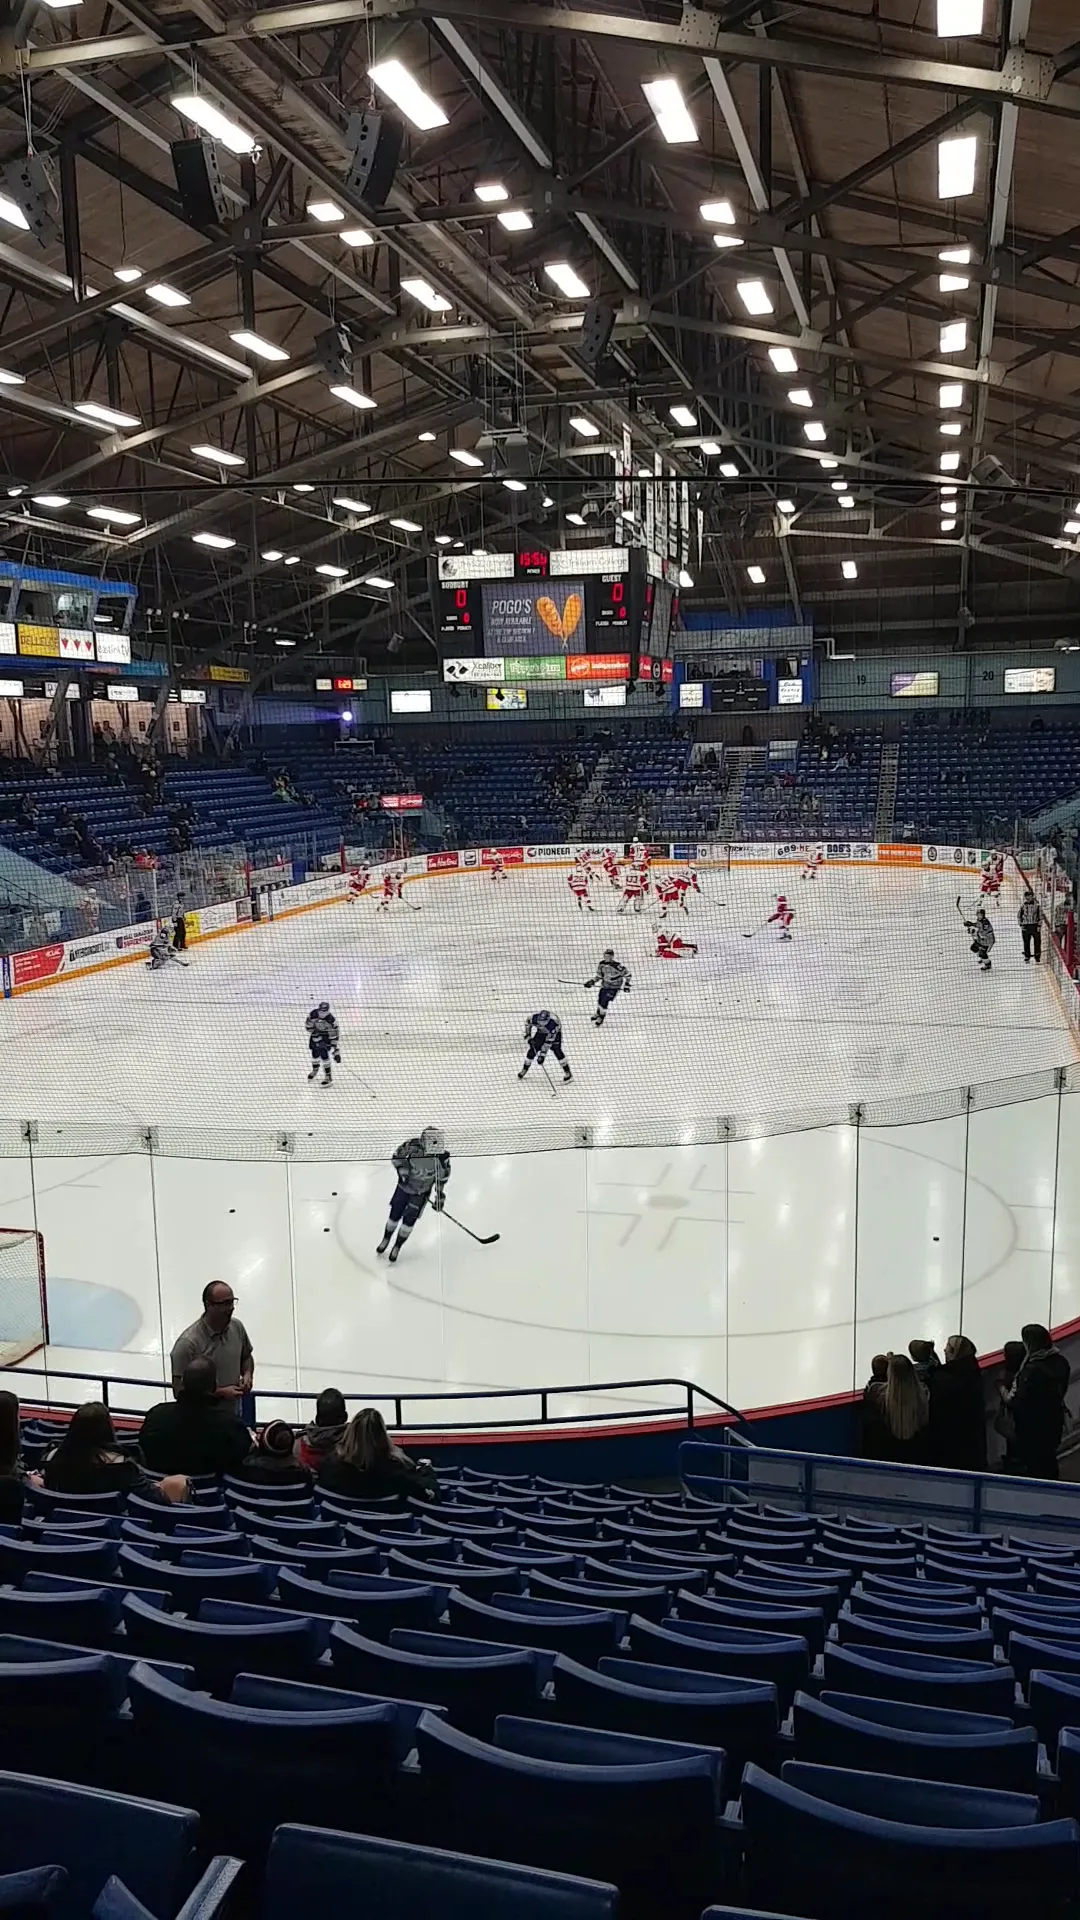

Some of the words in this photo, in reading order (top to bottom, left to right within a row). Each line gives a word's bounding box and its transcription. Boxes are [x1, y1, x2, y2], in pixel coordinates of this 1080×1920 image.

[601, 574, 622, 583] GUEST
[455, 589, 467, 608] 0
[612, 583, 624, 603] 0
[491, 599, 532, 614] POGO'S
[856, 675, 867, 685] 19
[982, 671, 994, 682] 20
[538, 847, 571, 857] PIONEER
